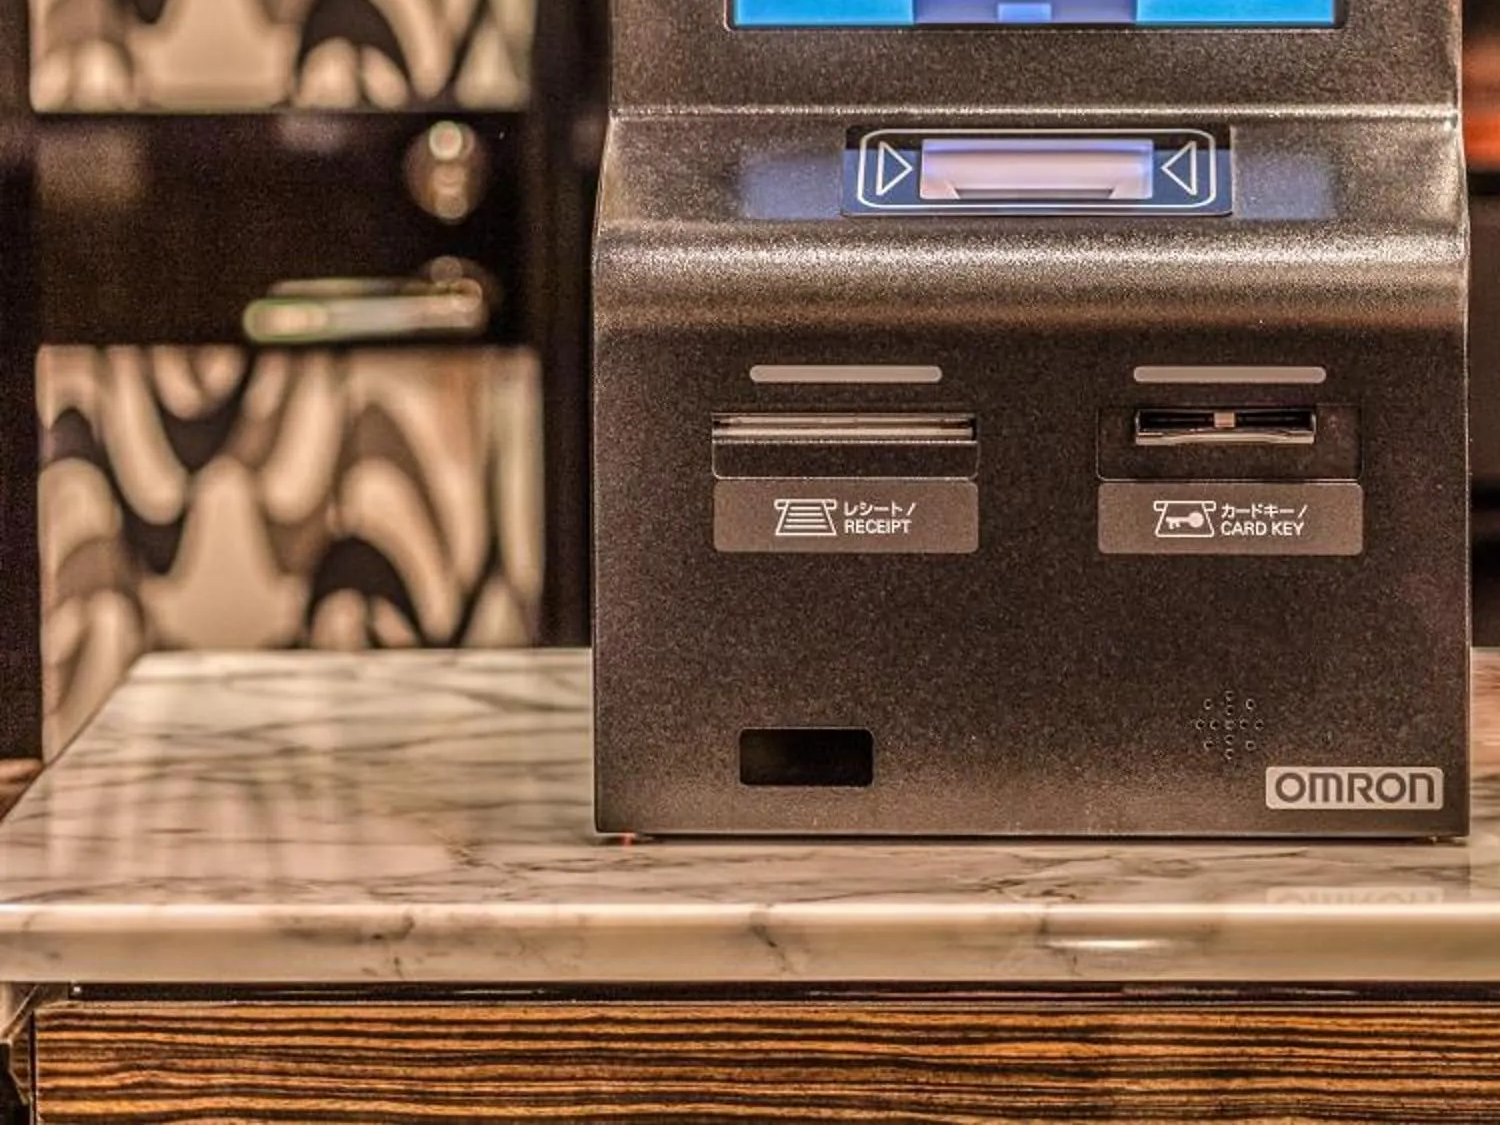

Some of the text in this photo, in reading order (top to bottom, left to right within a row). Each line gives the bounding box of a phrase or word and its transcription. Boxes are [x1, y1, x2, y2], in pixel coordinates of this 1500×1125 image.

[844, 518, 912, 534] RECEIPT
[1221, 521, 1304, 535] CARD KEY
